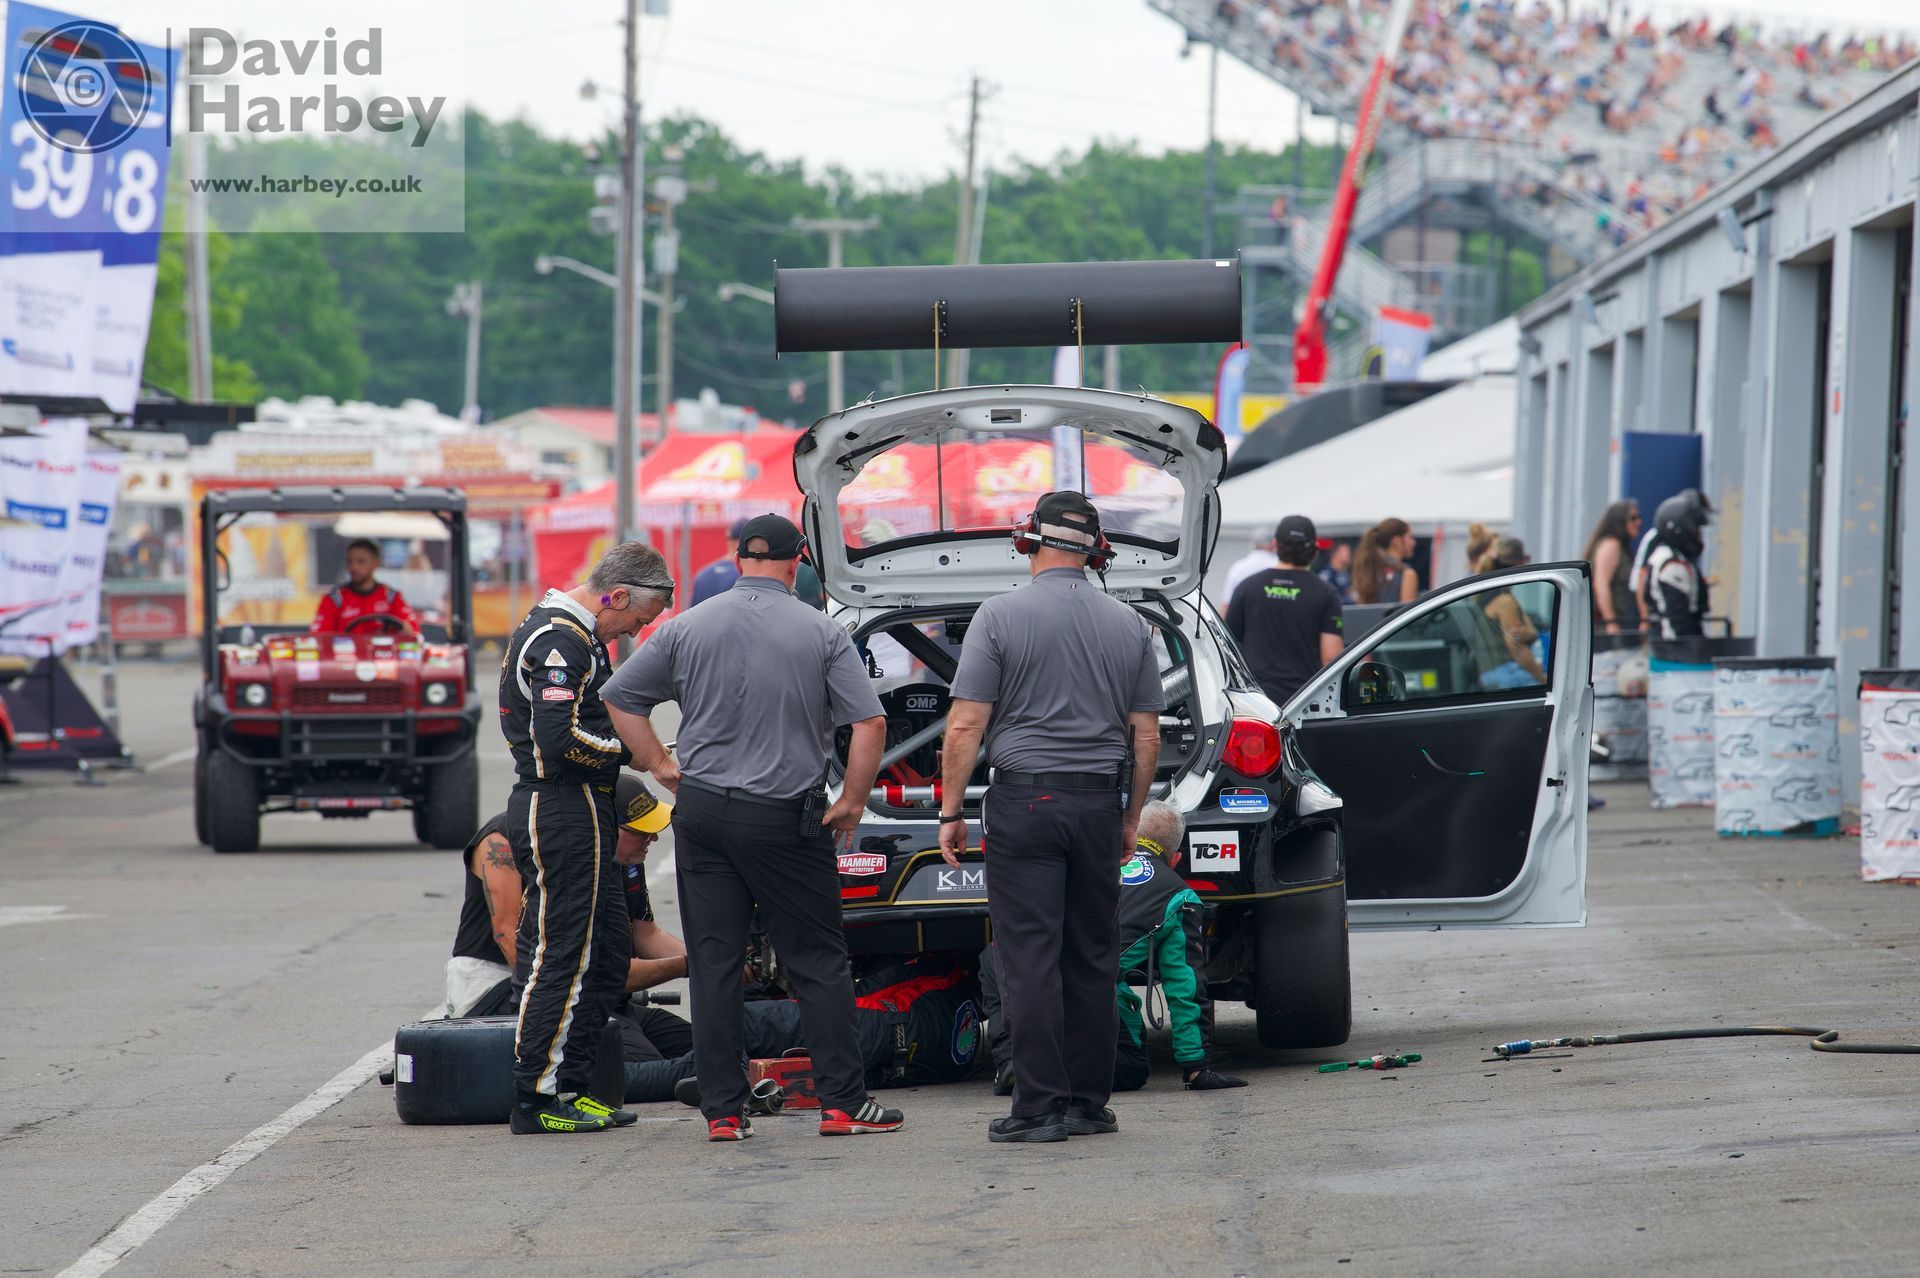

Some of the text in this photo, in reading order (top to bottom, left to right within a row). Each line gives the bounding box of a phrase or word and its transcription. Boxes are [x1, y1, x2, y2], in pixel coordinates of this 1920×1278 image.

[906, 697, 937, 708] OMP
[564, 747, 608, 769] Sabelt
[1191, 843, 1237, 860] TCR
[839, 857, 883, 868] HAMMER
[547, 1119, 576, 1130] sparco
